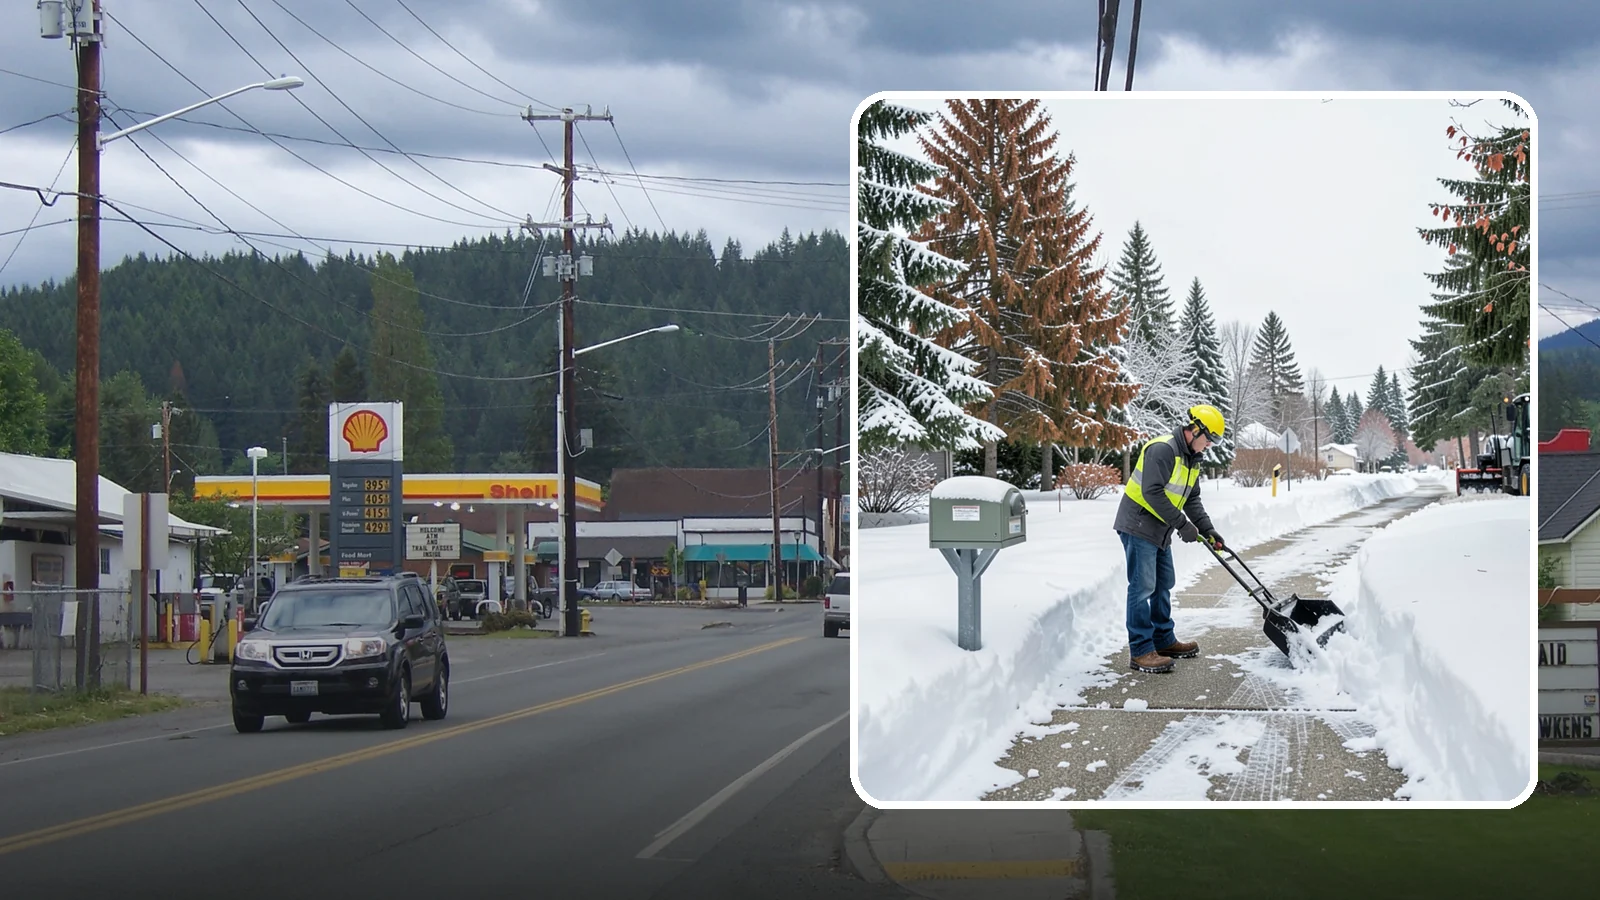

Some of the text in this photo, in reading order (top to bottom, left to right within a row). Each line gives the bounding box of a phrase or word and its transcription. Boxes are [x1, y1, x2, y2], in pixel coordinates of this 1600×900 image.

[366, 480, 384, 490] 395
[490, 485, 547, 499] Shell
[366, 494, 384, 504] 405
[366, 508, 384, 518] 415
[366, 522, 384, 532] 429
[1539, 643, 1566, 665] AID
